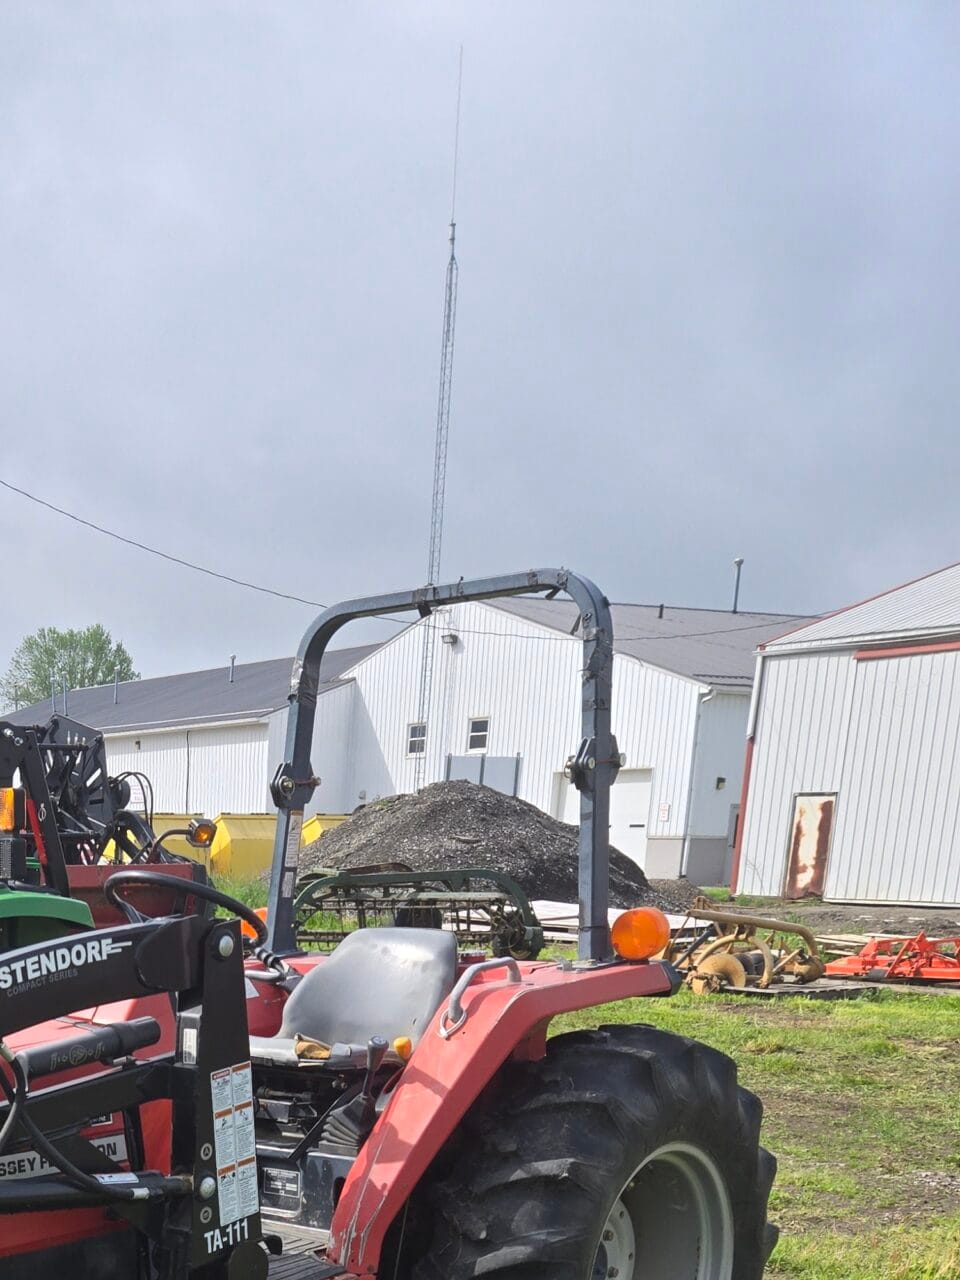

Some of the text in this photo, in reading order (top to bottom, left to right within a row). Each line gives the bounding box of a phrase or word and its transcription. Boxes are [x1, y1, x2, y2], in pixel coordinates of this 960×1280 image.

[6, 967, 79, 997] COMPACT SERIES
[203, 1217, 249, 1254] TA-111
